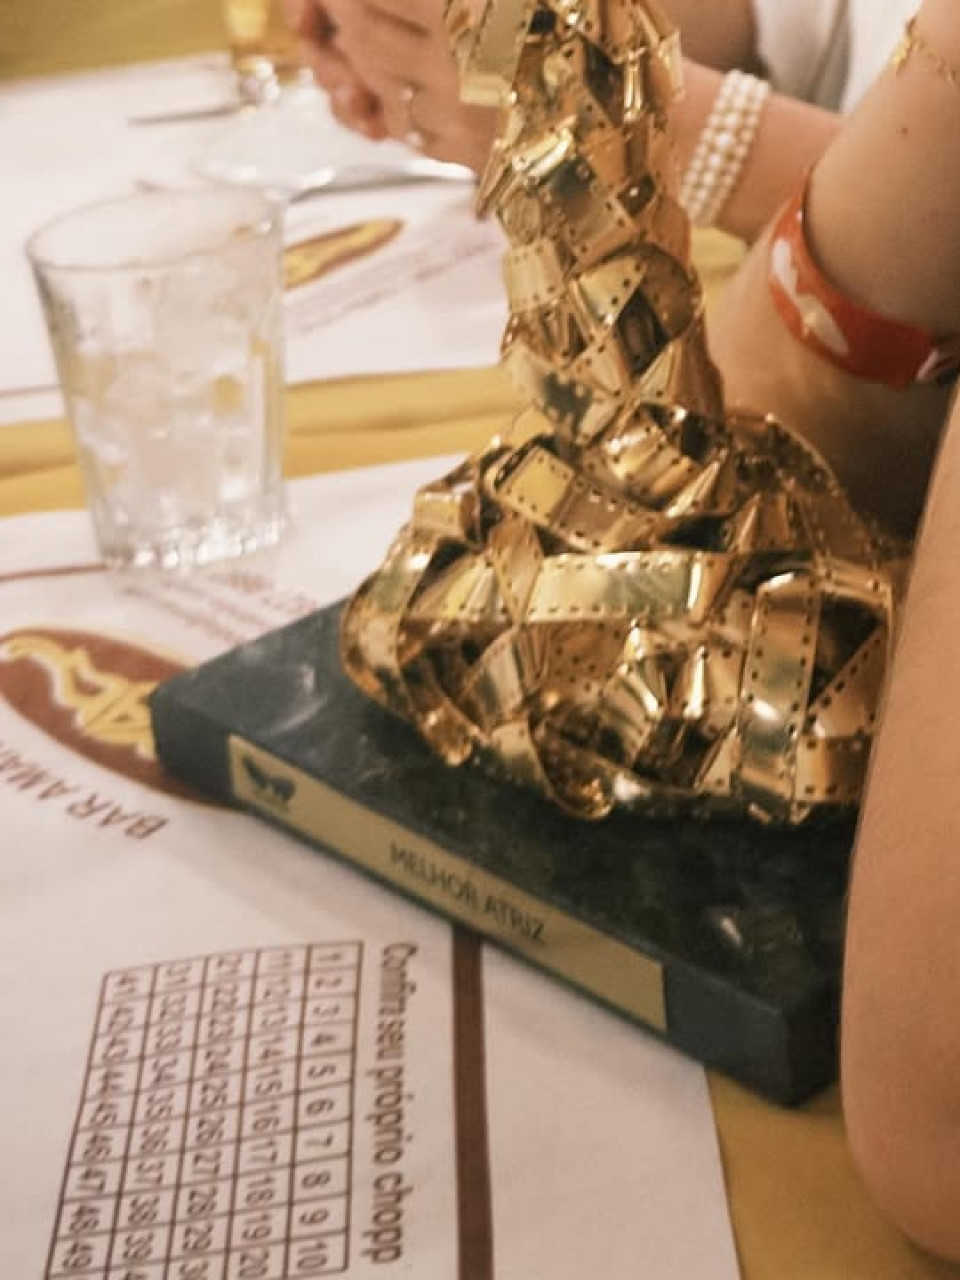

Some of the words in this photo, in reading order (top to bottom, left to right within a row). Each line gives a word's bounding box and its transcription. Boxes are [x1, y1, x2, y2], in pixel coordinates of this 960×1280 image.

[66, 793, 170, 839] BAR
[390, 840, 478, 910] MELHOR
[484, 895, 545, 945] ATRIZ
[215, 953, 243, 977] 21
[269, 951, 292, 969] 11
[319, 952, 342, 961] 1
[113, 973, 140, 997] 41
[165, 962, 193, 987] 31
[263, 976, 290, 999] 12
[315, 976, 342, 988] 2
[160, 993, 188, 1022] 32
[212, 982, 240, 1011] 22
[107, 1006, 135, 1036] 42
[261, 1006, 288, 1027] 13
[313, 1005, 340, 1017] 3
[155, 1024, 182, 1054] 33
[207, 1015, 235, 1041] 23
[312, 1033, 337, 1047] 4
[376, 1020, 405, 1059] seu
[102, 1037, 129, 1065] 43
[205, 1045, 231, 1077] 24
[258, 1035, 285, 1061] 14
[98, 1069, 124, 1097] 44
[151, 1056, 178, 1087] 34
[255, 1067, 282, 1095] 15
[307, 1064, 337, 1079] 5
[146, 1091, 174, 1119] 35
[200, 1080, 228, 1108] 25
[306, 1098, 334, 1116] 6
[90, 1100, 119, 1127] 45
[253, 1104, 280, 1132] 16
[364, 1065, 415, 1164] próprio
[140, 1125, 170, 1154] 36
[197, 1116, 225, 1144] 26
[304, 1132, 333, 1147] 7
[82, 1132, 112, 1161] 46
[250, 1140, 278, 1163] 17
[134, 1160, 165, 1184] 37
[192, 1149, 221, 1177] 27
[75, 1167, 106, 1192] 47
[246, 1175, 275, 1205] 18
[301, 1170, 332, 1189] 8
[128, 1195, 160, 1226] 38
[187, 1186, 217, 1216] 28
[69, 1204, 100, 1233] 48
[241, 1213, 271, 1240] 19
[299, 1208, 329, 1226] 9
[360, 1172, 414, 1265] chopp
[122, 1232, 154, 1261] 39
[182, 1222, 213, 1251] 29
[62, 1240, 94, 1270] 49
[239, 1249, 270, 1280] 20
[297, 1239, 327, 1270] 10
